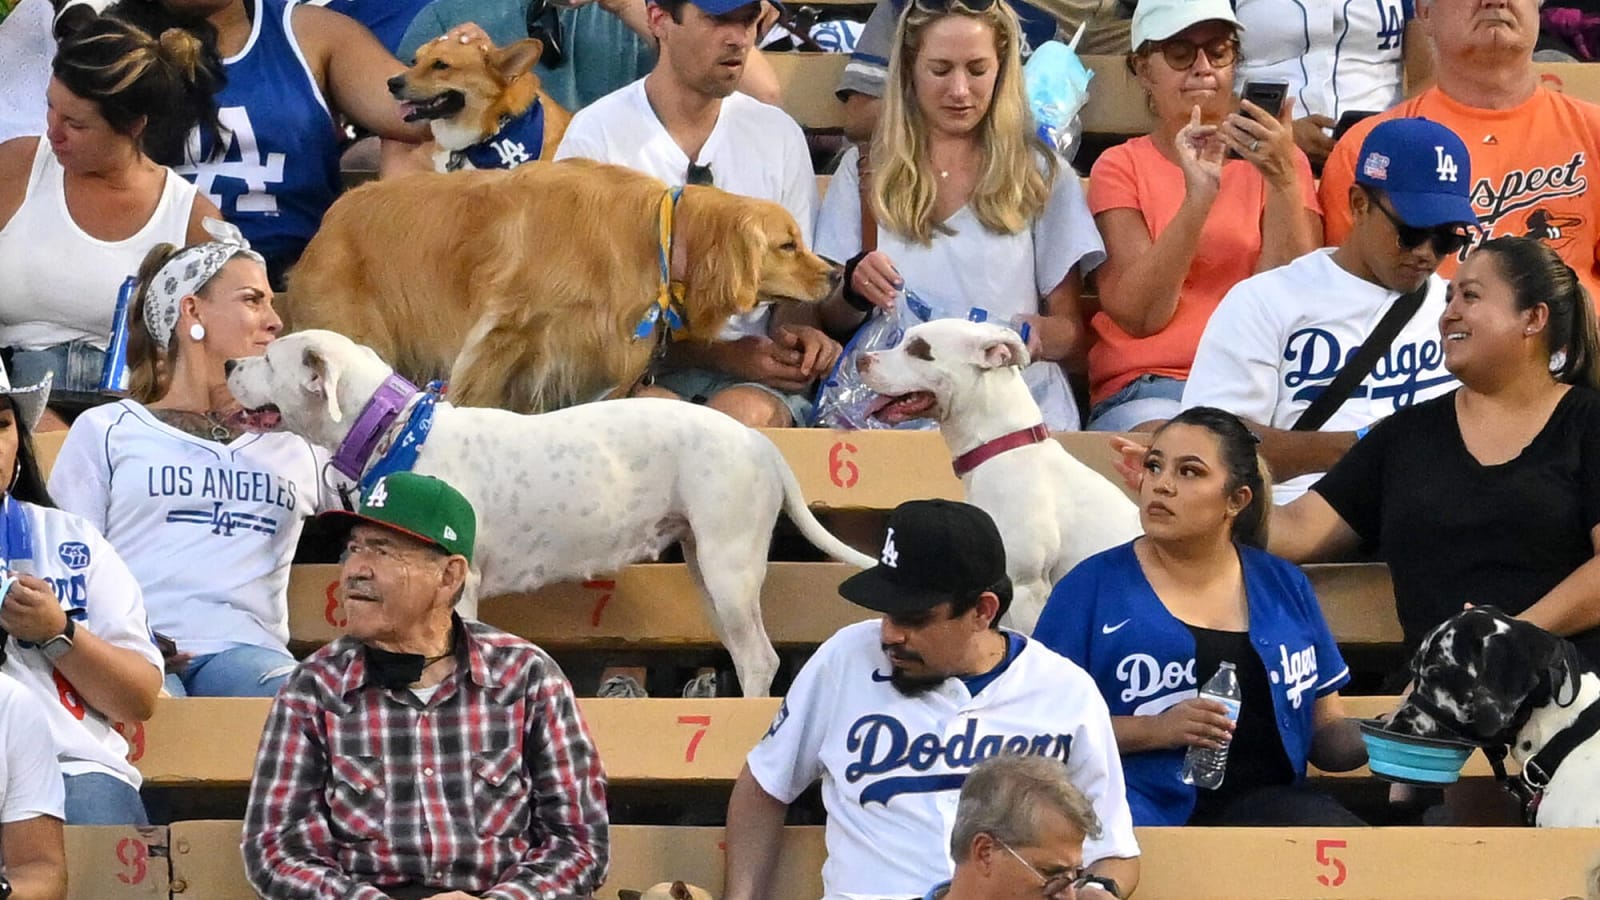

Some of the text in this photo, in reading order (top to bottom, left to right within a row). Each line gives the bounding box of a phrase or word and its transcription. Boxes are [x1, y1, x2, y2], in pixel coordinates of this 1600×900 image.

[489, 138, 530, 169] LA
[1435, 146, 1459, 182] LA
[1470, 152, 1586, 225] spect
[1284, 327, 1445, 411] Ddge
[149, 465, 297, 512] LOS ANGELES
[829, 442, 859, 488] 6
[366, 476, 388, 508] LA
[211, 501, 236, 537] LA
[881, 527, 899, 568] LA
[582, 580, 616, 628] 7
[678, 715, 711, 763] 7
[116, 838, 148, 885] 9
[1316, 839, 1347, 887] 5
